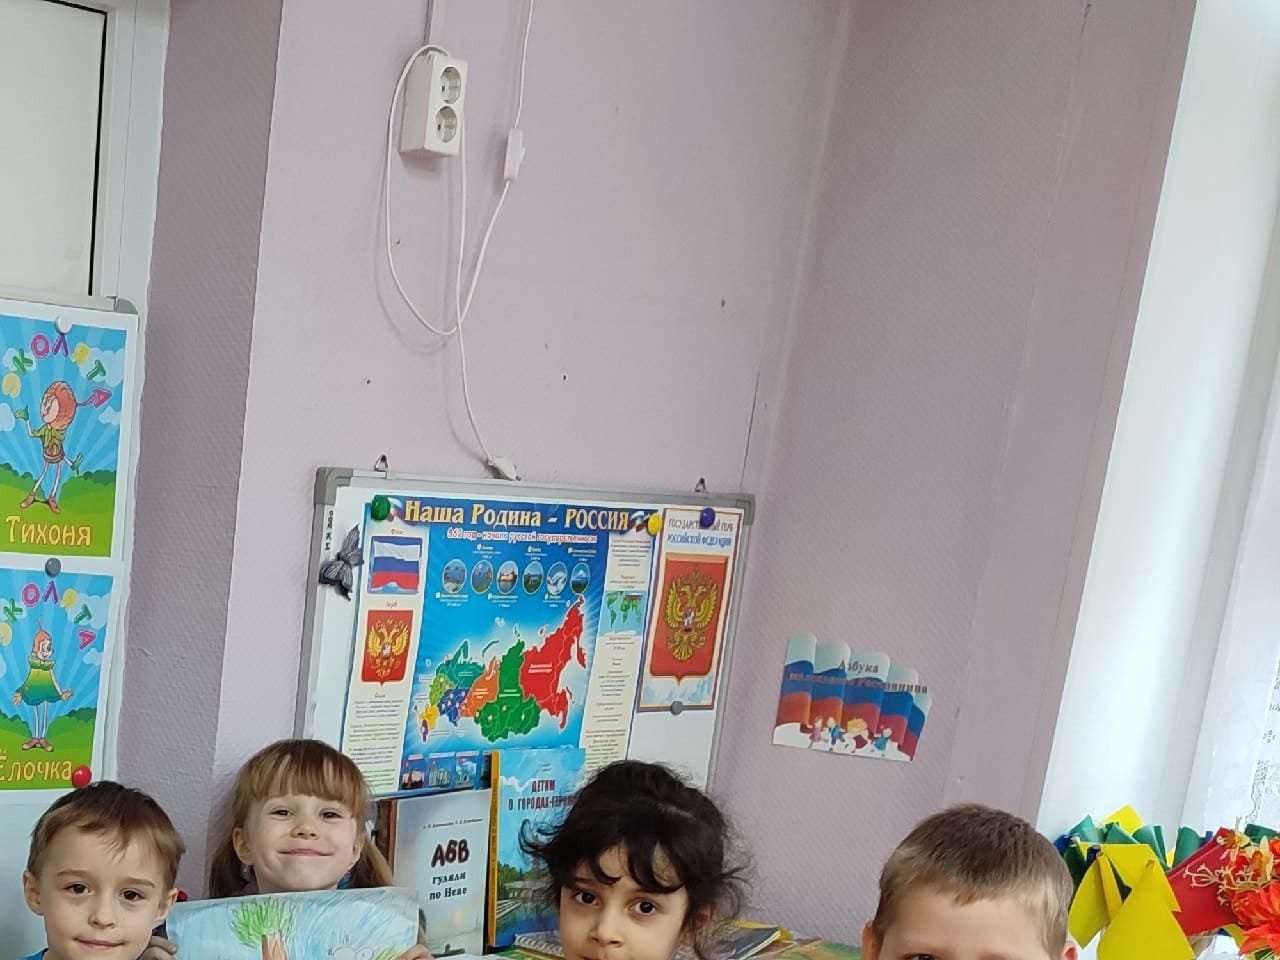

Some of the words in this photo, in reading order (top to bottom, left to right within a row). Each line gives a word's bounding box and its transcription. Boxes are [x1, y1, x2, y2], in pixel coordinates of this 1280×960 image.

[404, 500, 464, 524] Наша
[471, 503, 541, 529] Родина
[564, 508, 629, 531] РОССИЯ
[5, 515, 91, 547] Тихоня
[838, 659, 879, 674] Азбука
[431, 839, 470, 868] АБВ
[432, 872, 466, 885] гуляли
[429, 891, 441, 900] по
[444, 887, 467, 898] Неве
